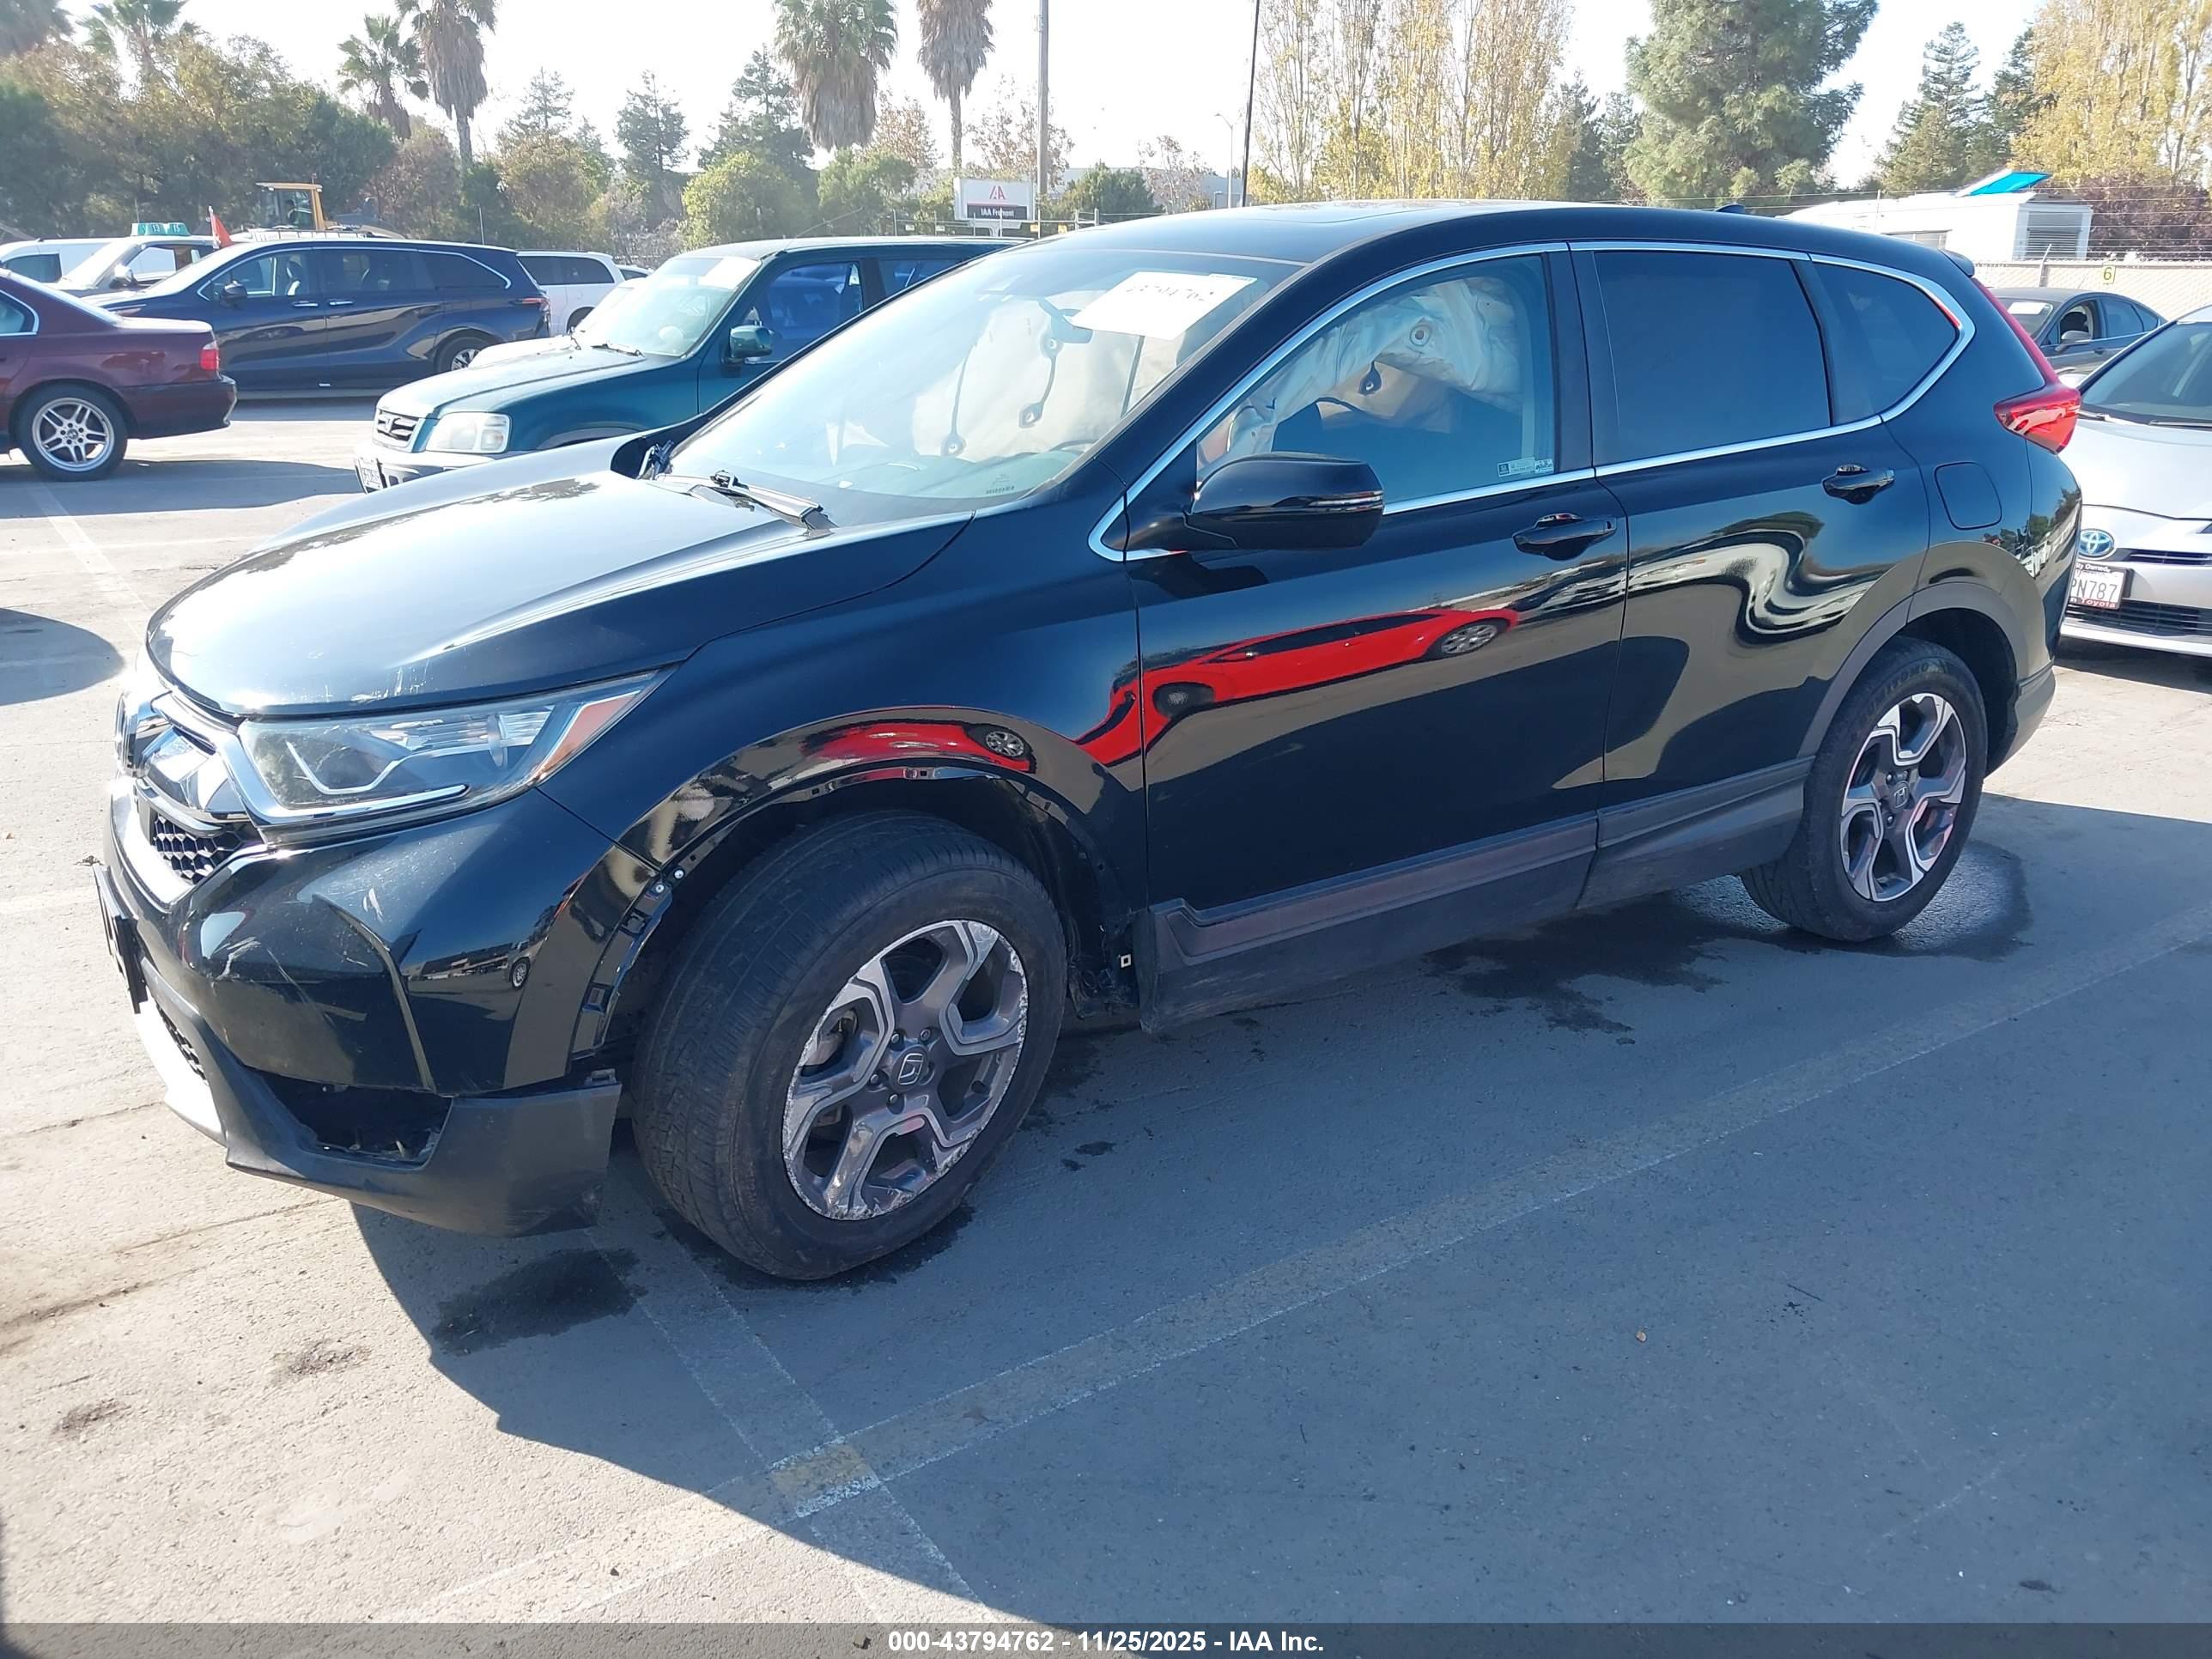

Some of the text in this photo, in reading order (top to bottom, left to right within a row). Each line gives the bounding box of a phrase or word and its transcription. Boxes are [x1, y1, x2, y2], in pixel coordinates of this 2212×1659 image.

[981, 207, 992, 216] IAA
[2103, 266, 2112, 280] 6
[2081, 598, 2116, 609] Toyota
